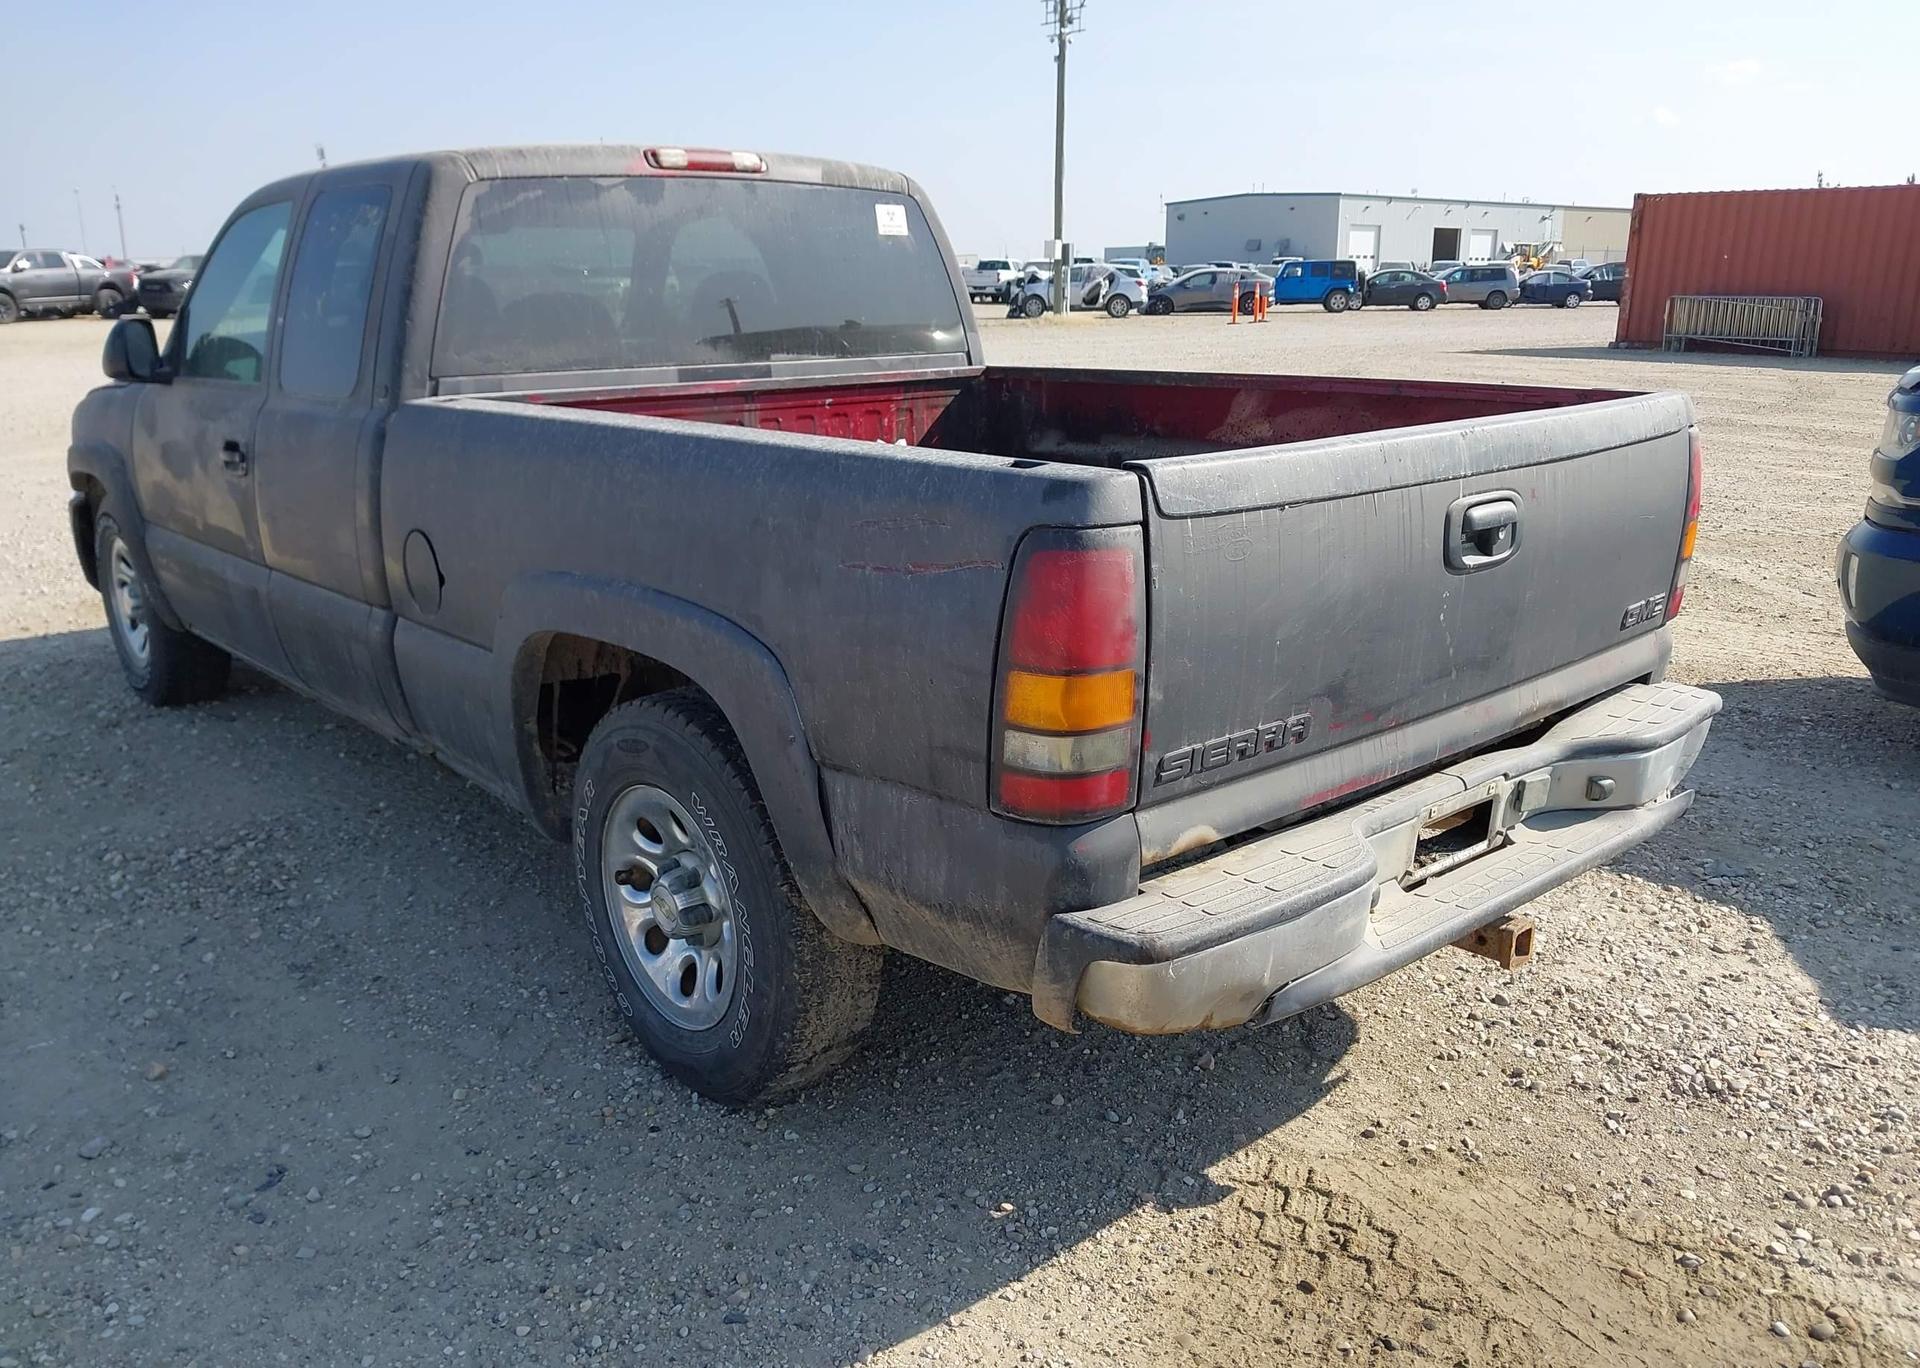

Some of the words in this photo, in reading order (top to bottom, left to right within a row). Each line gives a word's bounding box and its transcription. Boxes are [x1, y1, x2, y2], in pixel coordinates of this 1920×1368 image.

[1153, 712, 1313, 788] SIERRA
[576, 779, 633, 1017] GOODYEAR
[691, 791, 754, 1049] WRANGLER
